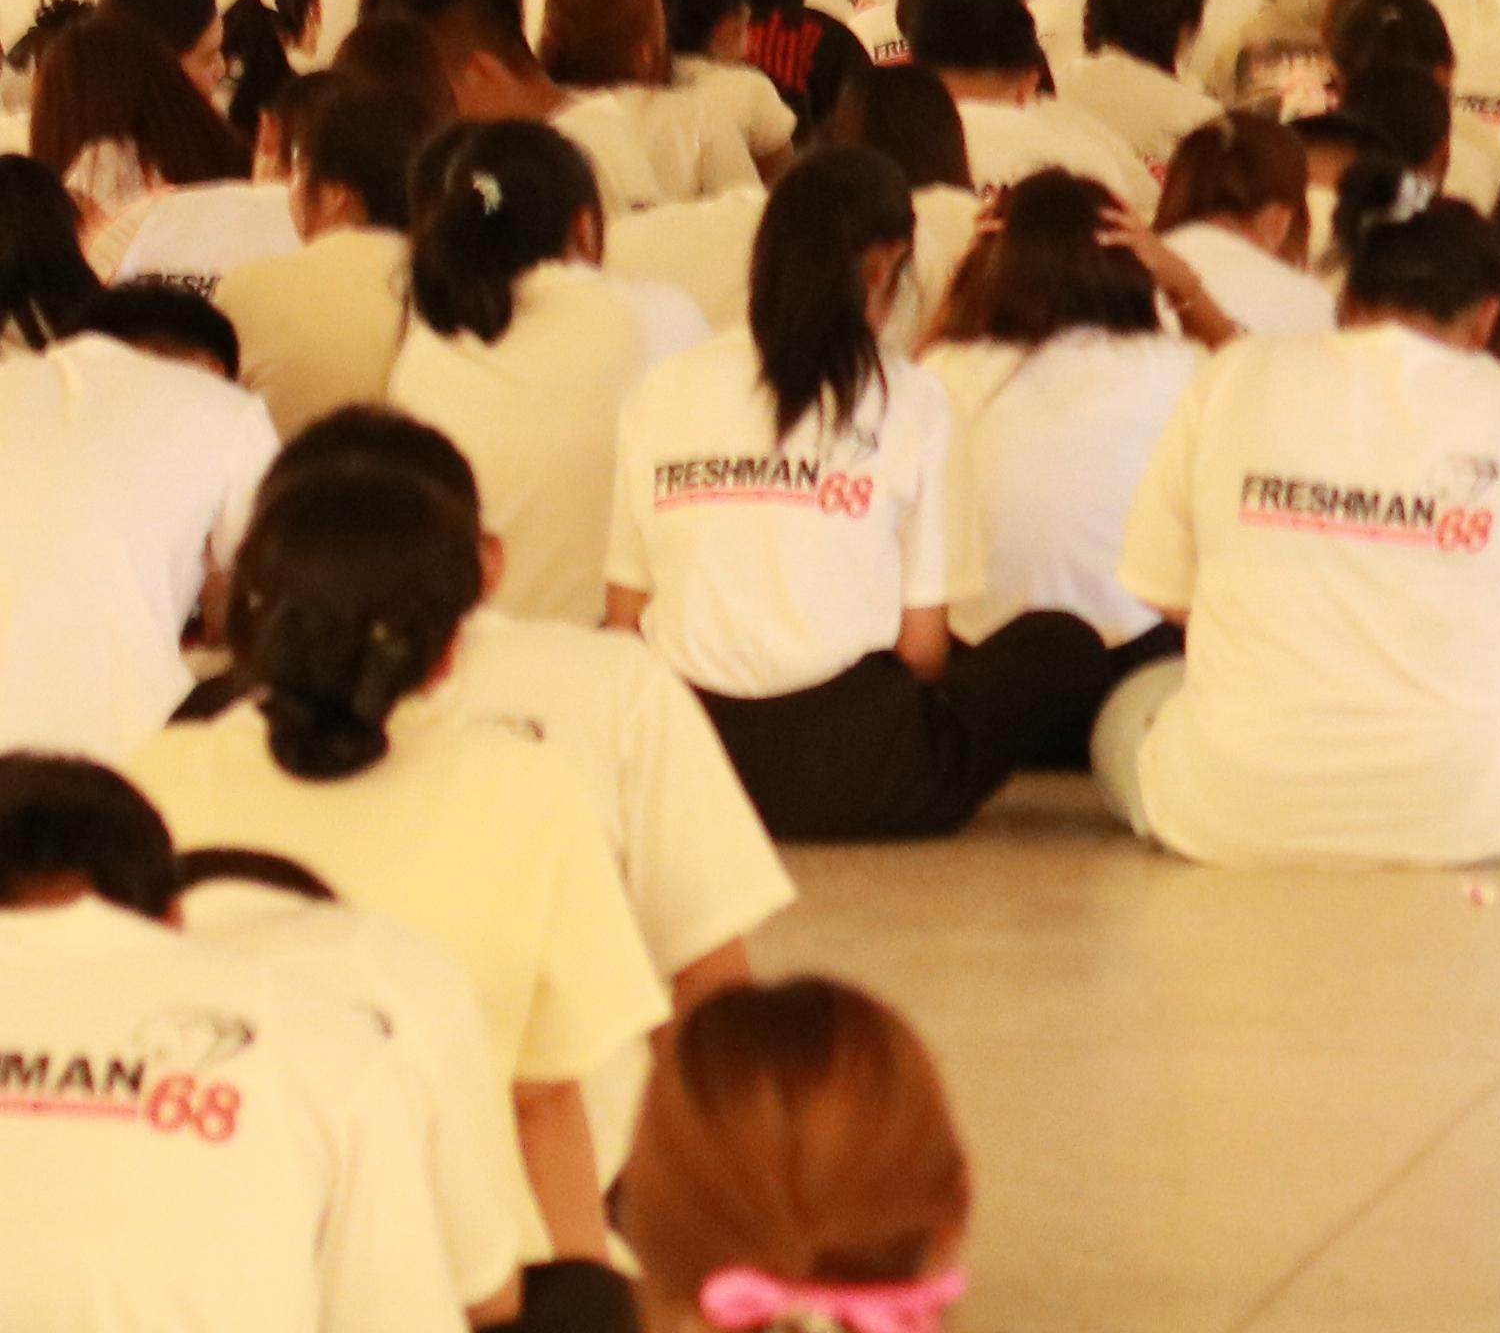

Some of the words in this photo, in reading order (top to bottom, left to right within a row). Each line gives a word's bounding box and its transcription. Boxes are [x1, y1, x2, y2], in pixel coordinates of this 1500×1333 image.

[655, 457, 821, 495] FRESHMAN
[818, 469, 874, 519] 68
[1241, 471, 1435, 528] FRESHMAN
[1436, 506, 1494, 554] 68
[149, 1072, 241, 1144] 68
